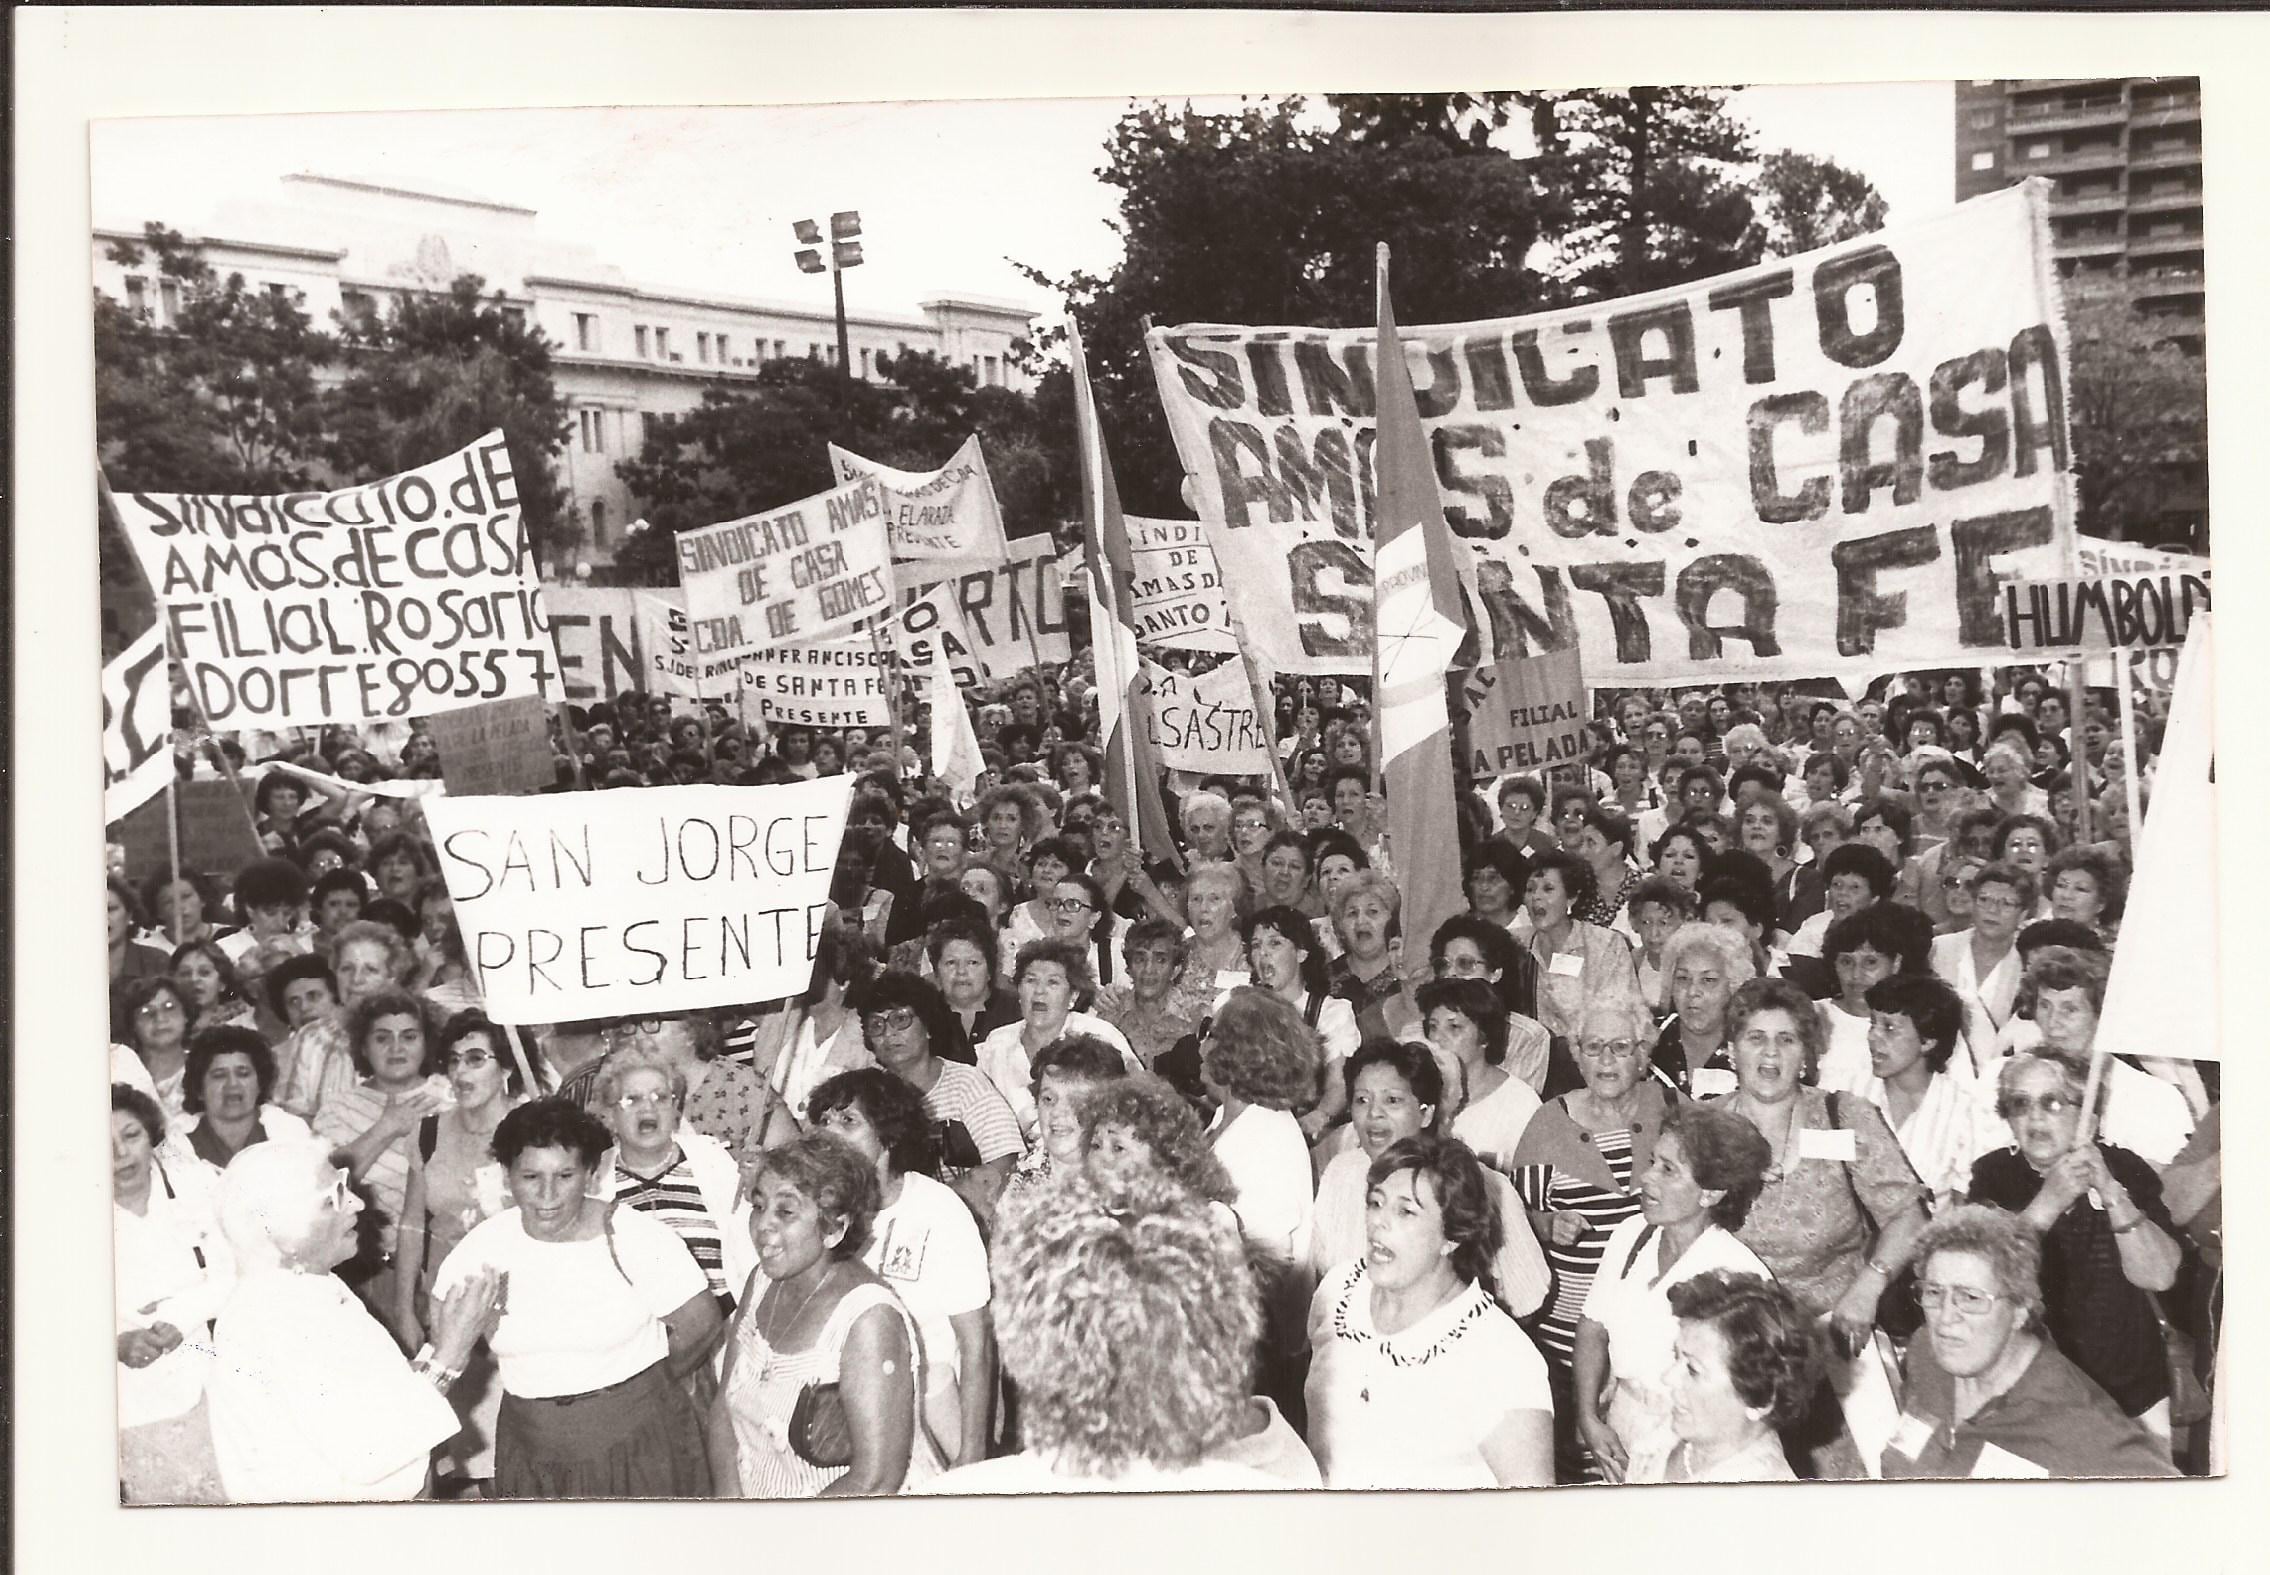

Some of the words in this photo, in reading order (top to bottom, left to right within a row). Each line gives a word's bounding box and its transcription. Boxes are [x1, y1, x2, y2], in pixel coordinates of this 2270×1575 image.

[1542, 435, 1684, 538] de
[1747, 324, 2069, 522] CASA
[679, 510, 810, 573] SINDICATO
[825, 480, 880, 533] AMAS
[738, 563, 770, 605] DE
[791, 540, 849, 590] CASA
[1169, 549, 1198, 567] DE
[766, 599, 801, 638] DE
[744, 671, 767, 689] DE
[776, 675, 857, 697] SANTA
[761, 698, 869, 725] PRESENTE
[1510, 700, 1579, 729] FILIAL
[1497, 728, 1590, 770] PELADA
[444, 823, 592, 902] SAN
[637, 815, 830, 885] JORGE
[477, 902, 828, 998] PRESENTE
